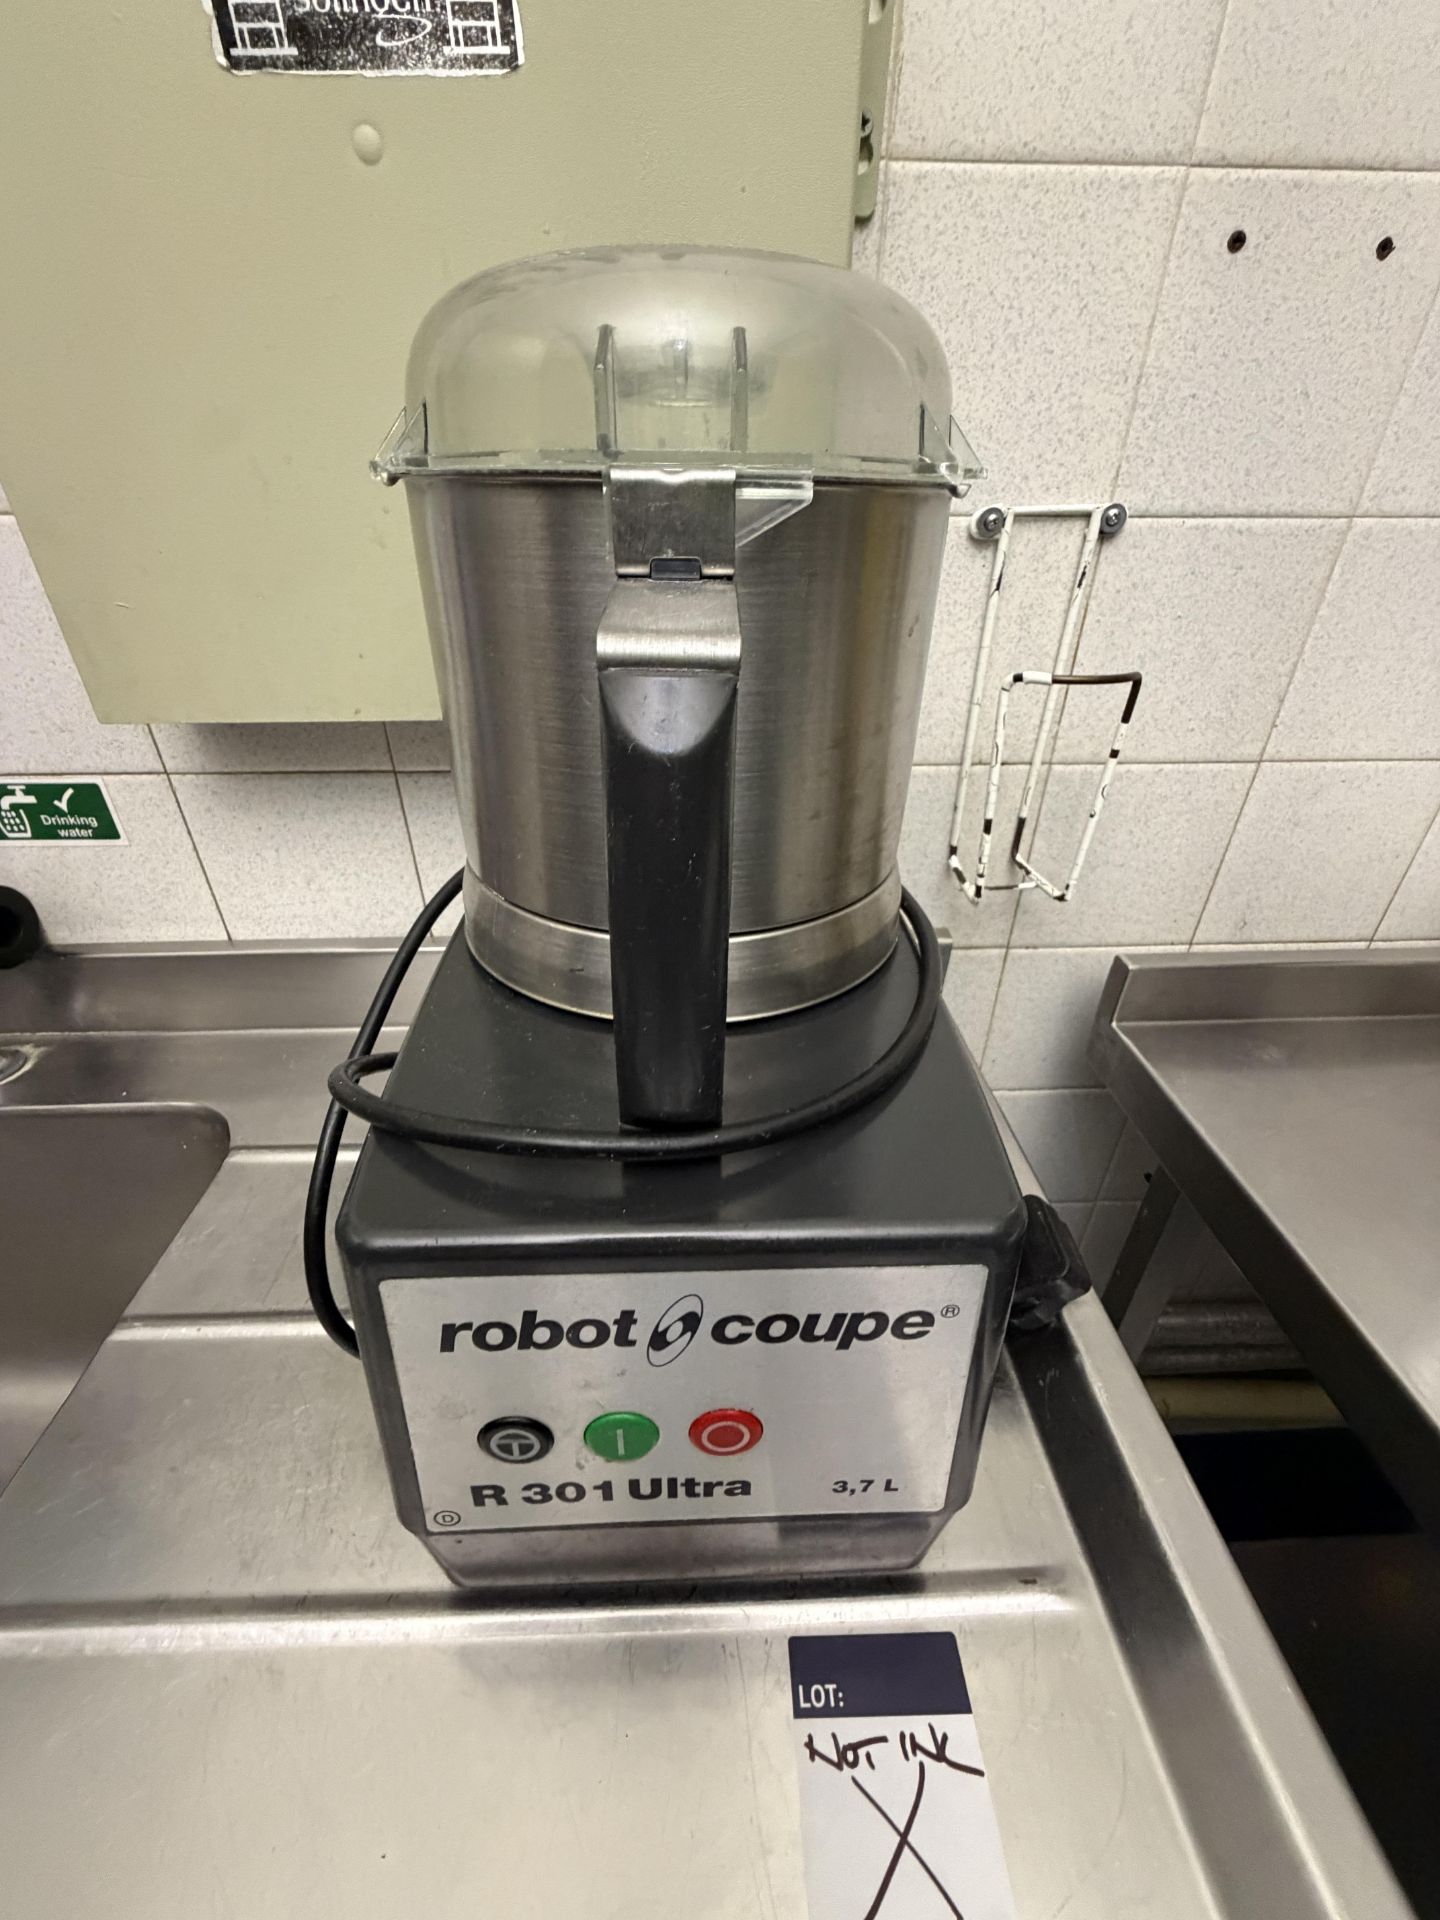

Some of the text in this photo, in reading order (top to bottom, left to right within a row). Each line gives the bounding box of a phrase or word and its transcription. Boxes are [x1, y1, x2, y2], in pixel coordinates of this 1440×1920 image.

[40, 814, 98, 828] Drinking
[57, 827, 93, 838] water
[439, 1309, 638, 1353] robot
[470, 1477, 752, 1507] R 301 Ultra
[831, 1478, 899, 1496] 3,7 L
[798, 1683, 844, 1709] LOT:
